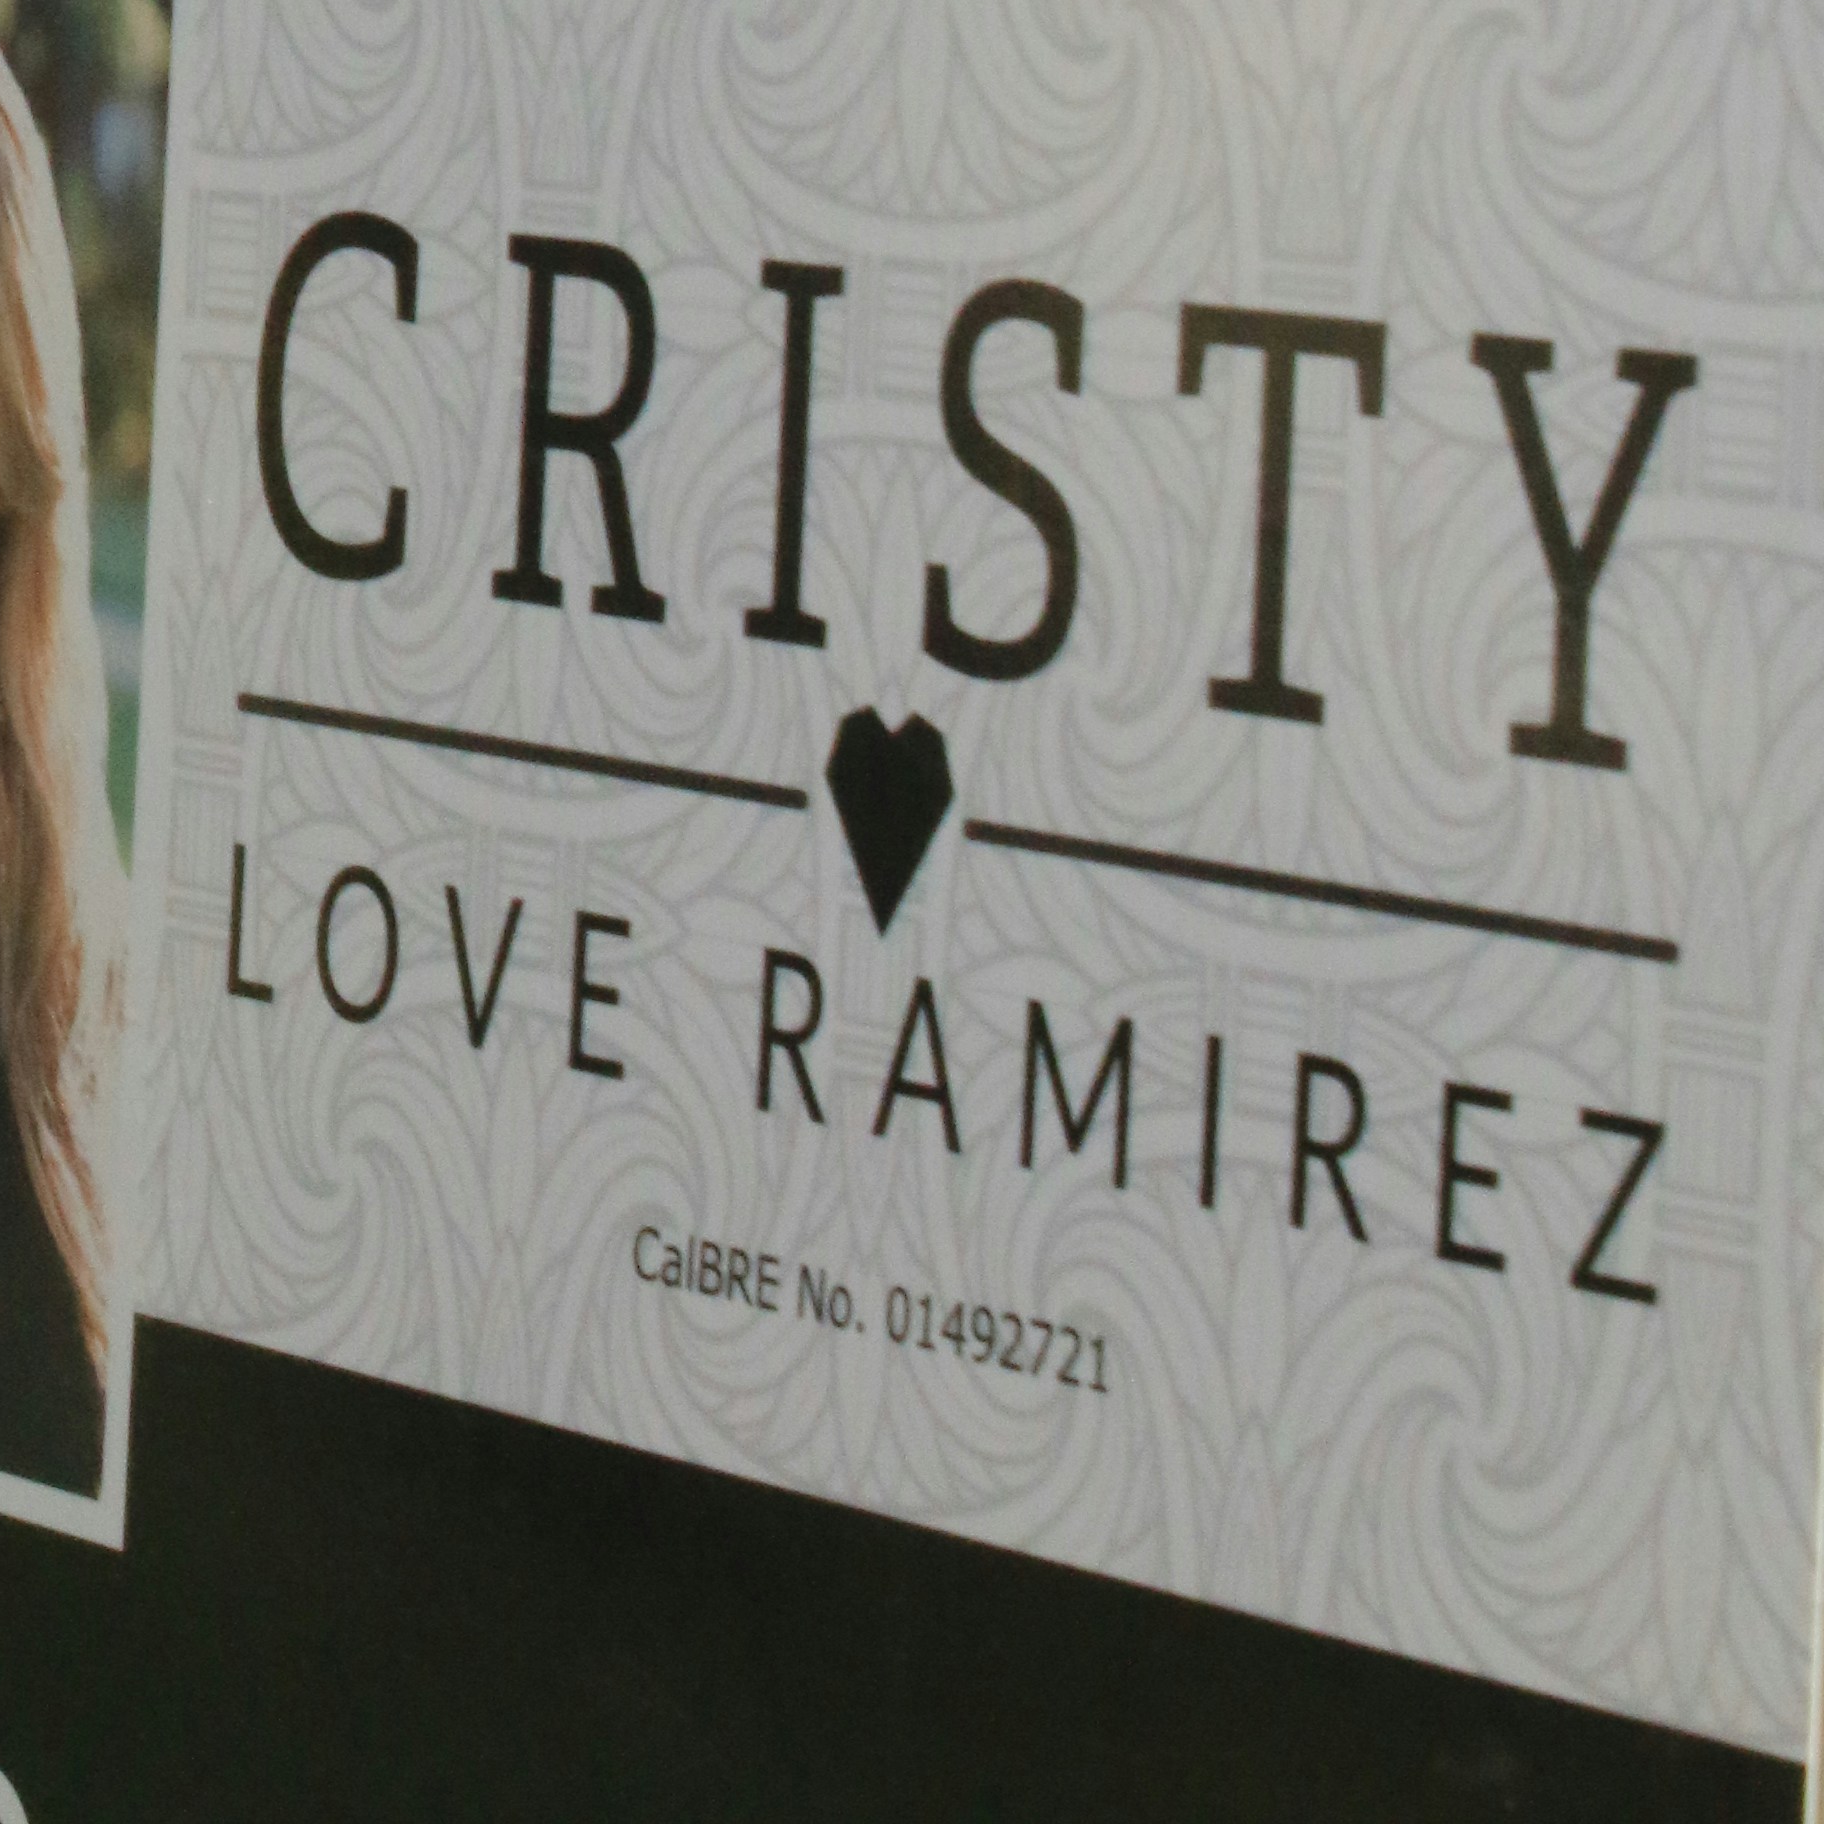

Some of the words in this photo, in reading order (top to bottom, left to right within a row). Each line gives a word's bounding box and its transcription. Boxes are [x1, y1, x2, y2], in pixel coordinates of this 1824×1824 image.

[255, 209, 1698, 772] CRISTY
[226, 843, 632, 1082] LOVE
[755, 947, 1666, 1307] RAMIREZ
[632, 1225, 781, 1313] CalBRE
[796, 1263, 866, 1335] No.
[884, 1284, 1108, 1395] 01492721
